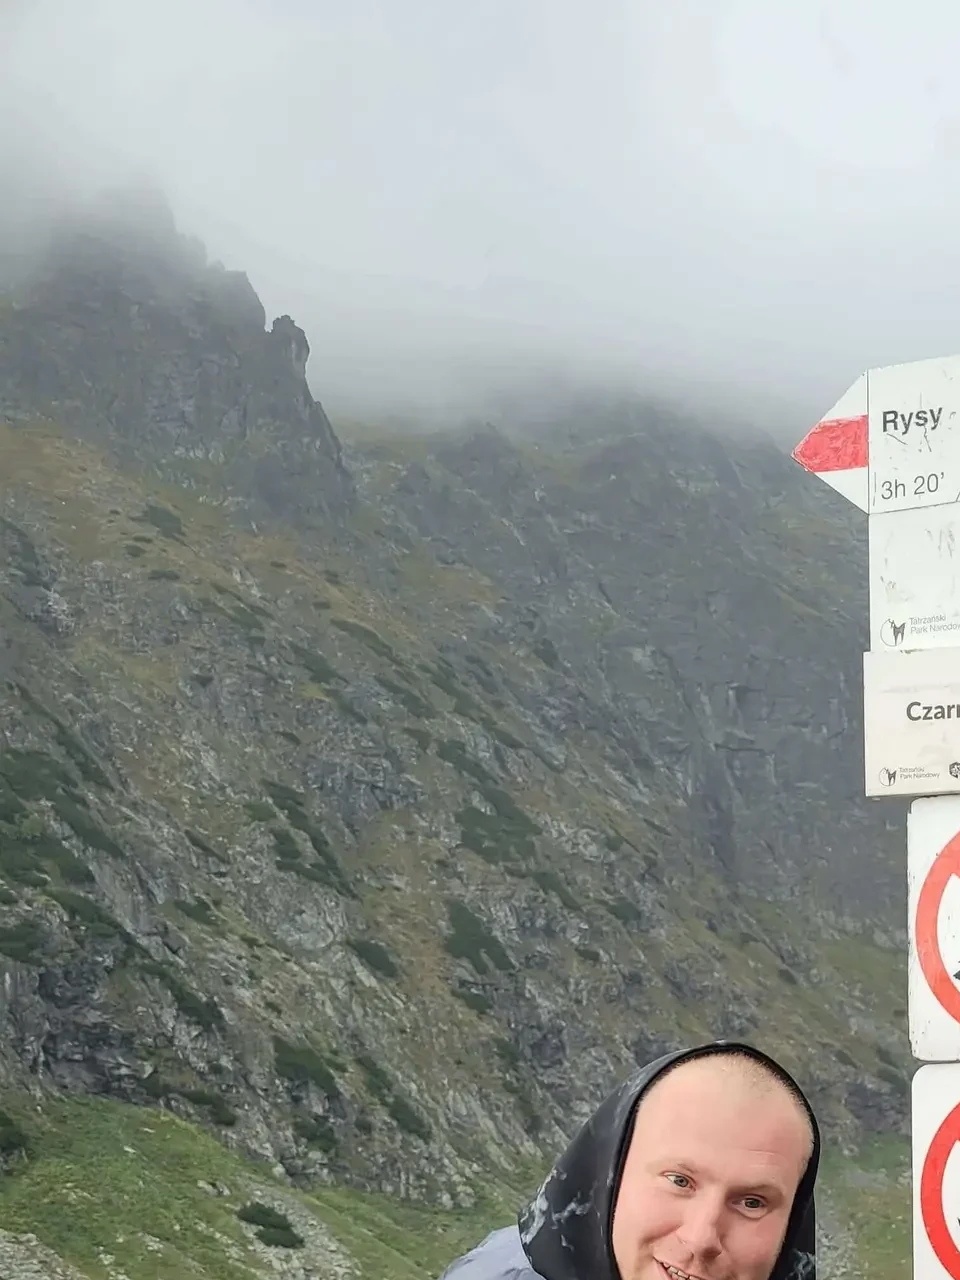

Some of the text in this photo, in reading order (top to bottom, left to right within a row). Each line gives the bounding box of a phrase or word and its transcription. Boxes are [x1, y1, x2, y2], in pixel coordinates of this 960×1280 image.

[881, 405, 944, 434] Rysy
[881, 480, 907, 500] 3h
[910, 625, 928, 635] Park
